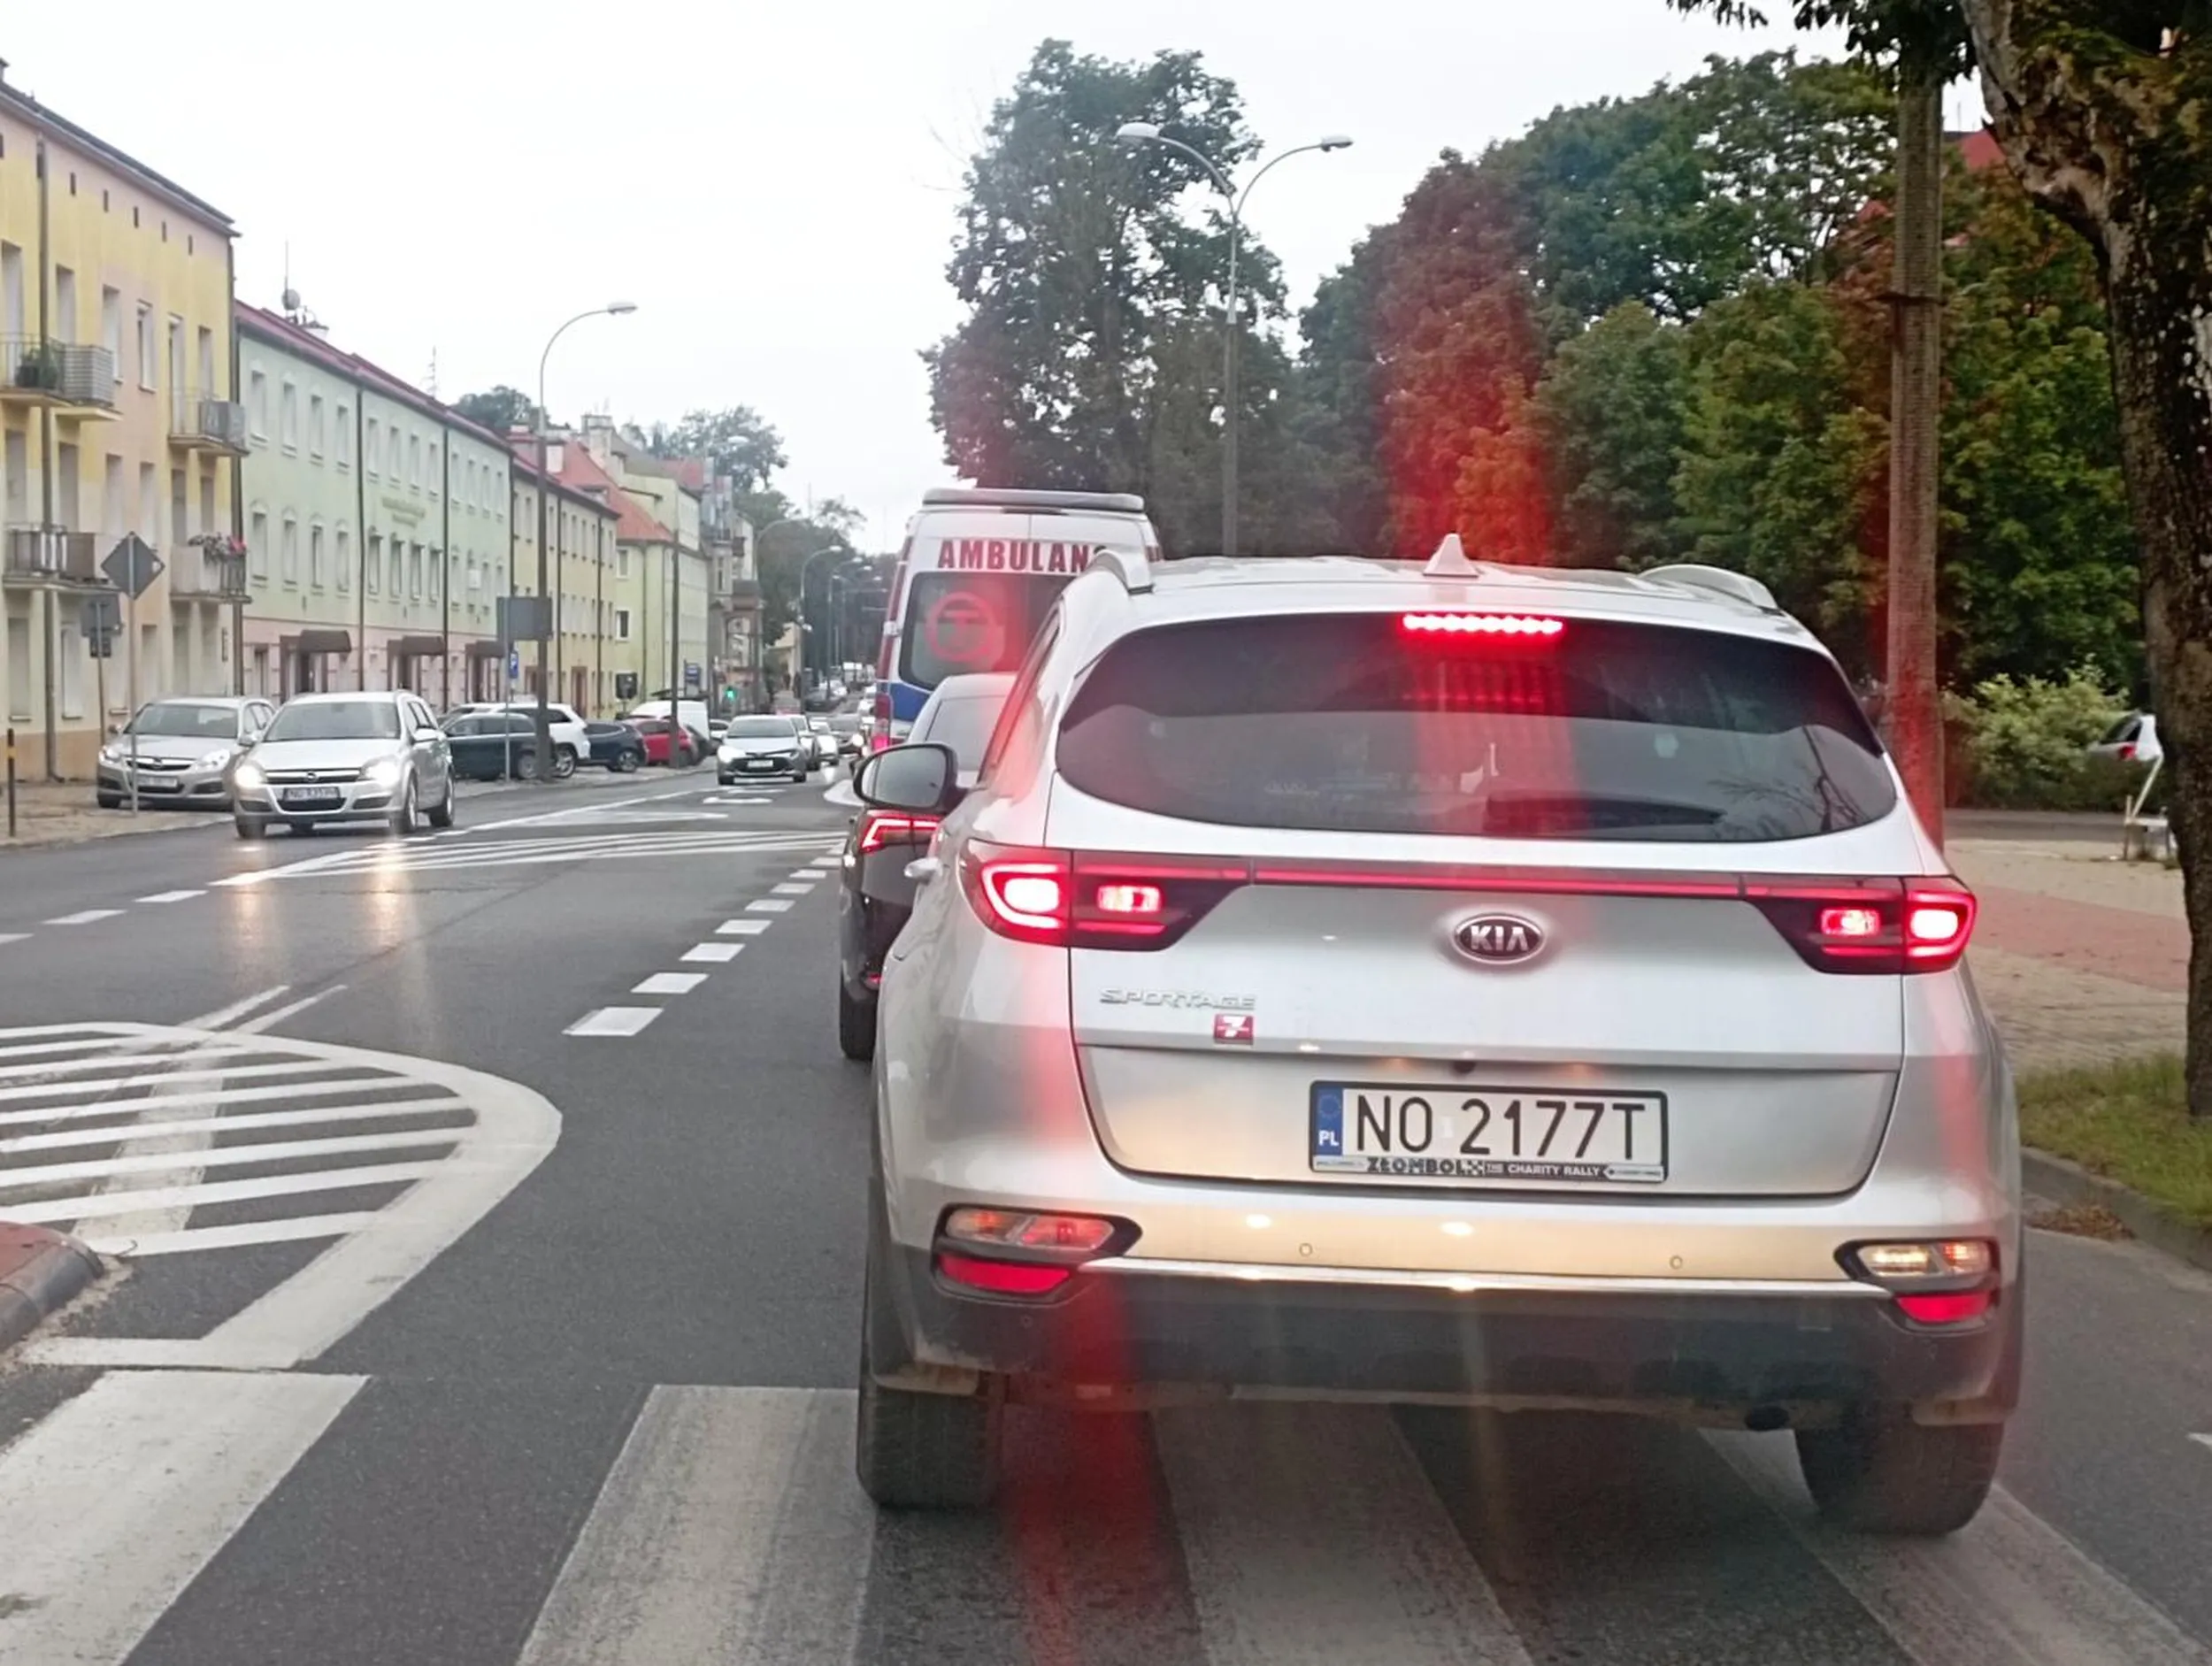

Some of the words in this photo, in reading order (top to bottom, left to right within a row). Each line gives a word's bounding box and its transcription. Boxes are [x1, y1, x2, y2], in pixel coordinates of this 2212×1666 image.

[937, 539, 1106, 573] AMBULAN
[1471, 925, 1528, 951] KIA
[1100, 988, 1255, 1010] SPORTAGE
[1318, 1130, 1340, 1147] PL
[1357, 1094, 1432, 1153] NO
[1460, 1097, 1646, 1160] 2177T
[1508, 1163, 1560, 1175] CHARITY
[1563, 1166, 1601, 1177] RALLY
